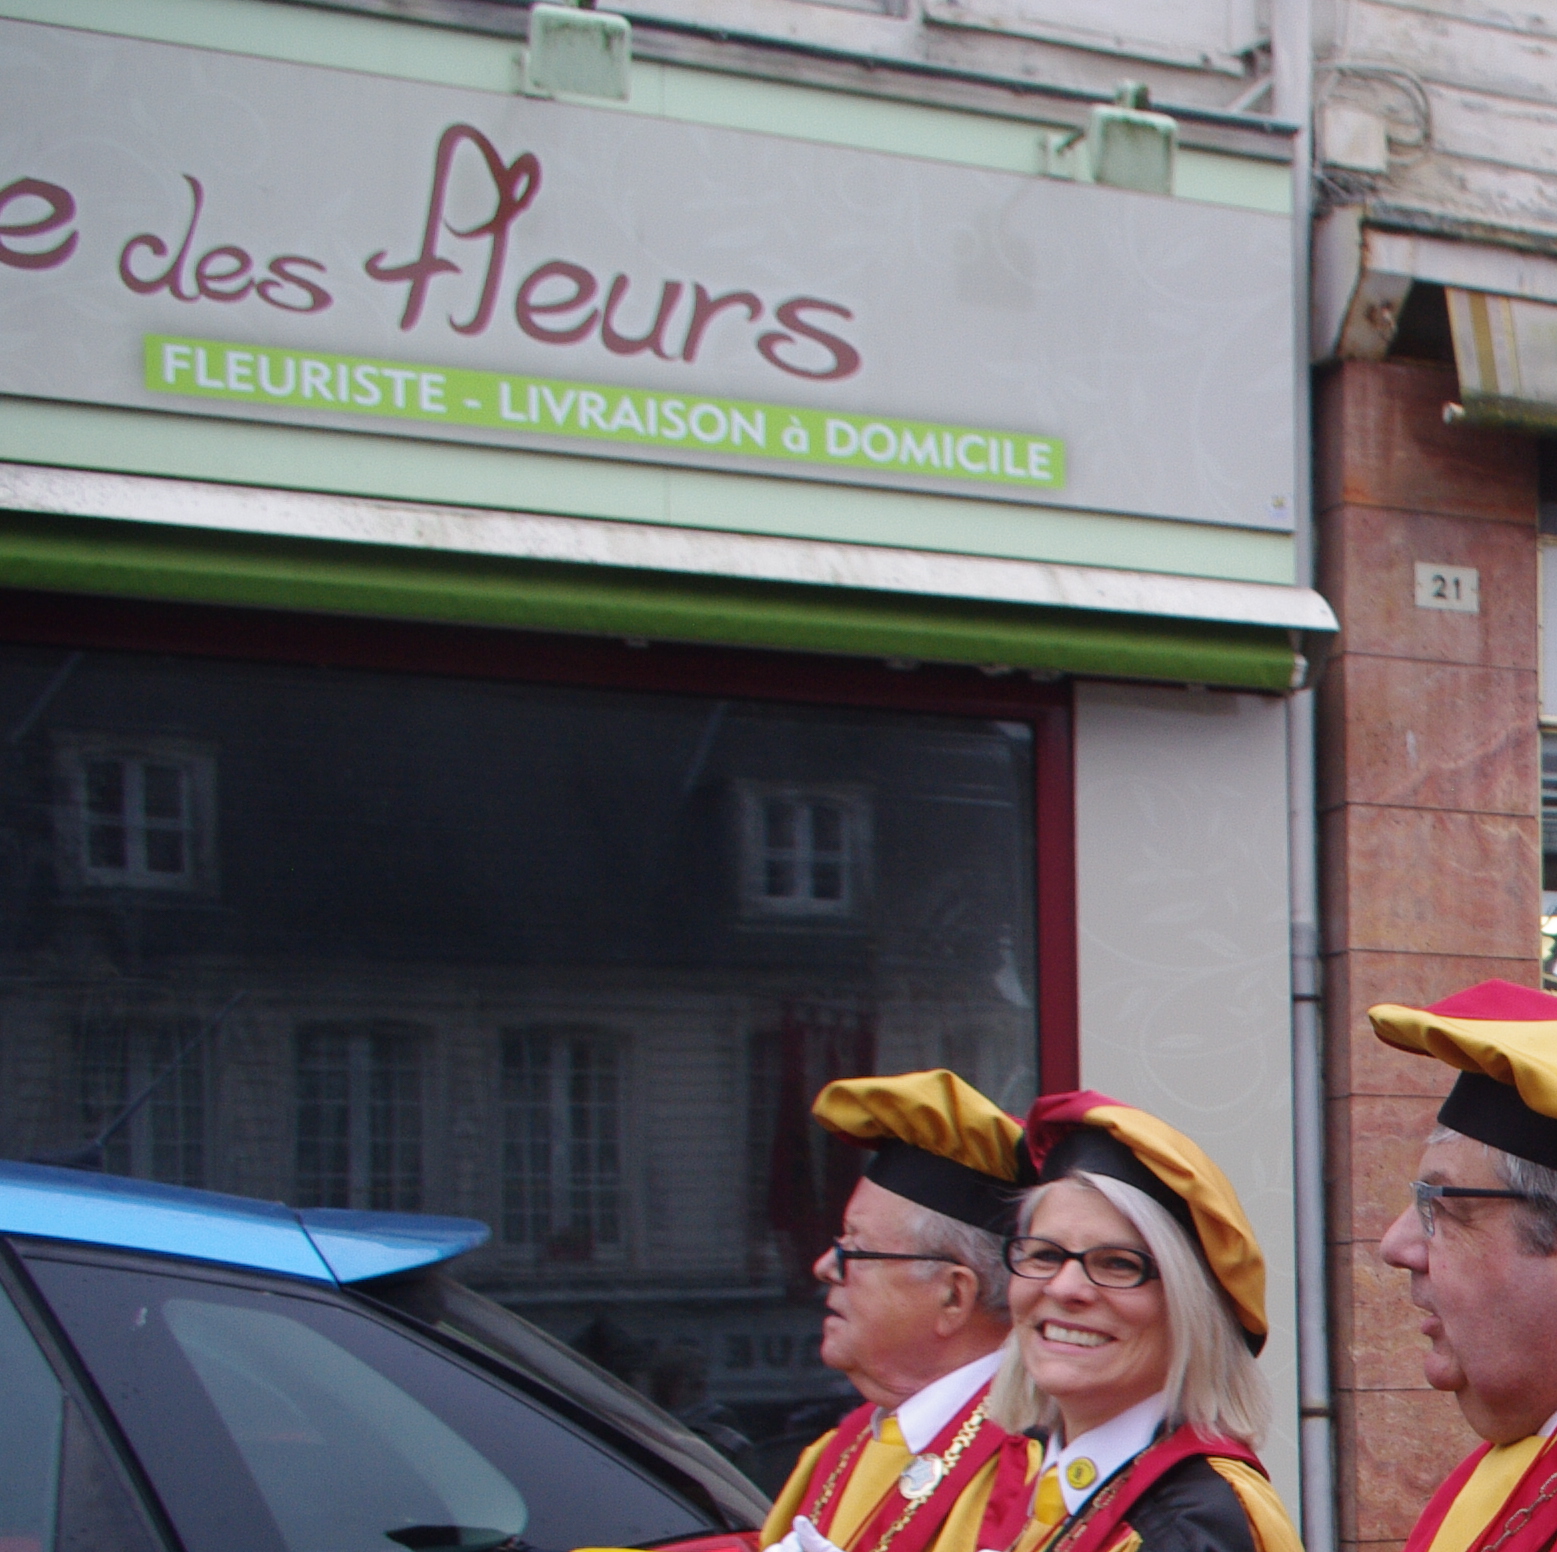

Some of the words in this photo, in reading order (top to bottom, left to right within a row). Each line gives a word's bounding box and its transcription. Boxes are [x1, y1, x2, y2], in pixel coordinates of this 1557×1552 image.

[119, 172, 334, 312] des
[364, 122, 863, 382] fleurs
[161, 342, 448, 415] FLEURISTE
[498, 380, 767, 452] LIVRAISON
[783, 414, 809, 455] à
[826, 421, 1053, 483] DOMICILE
[1432, 573, 1461, 600] 21
